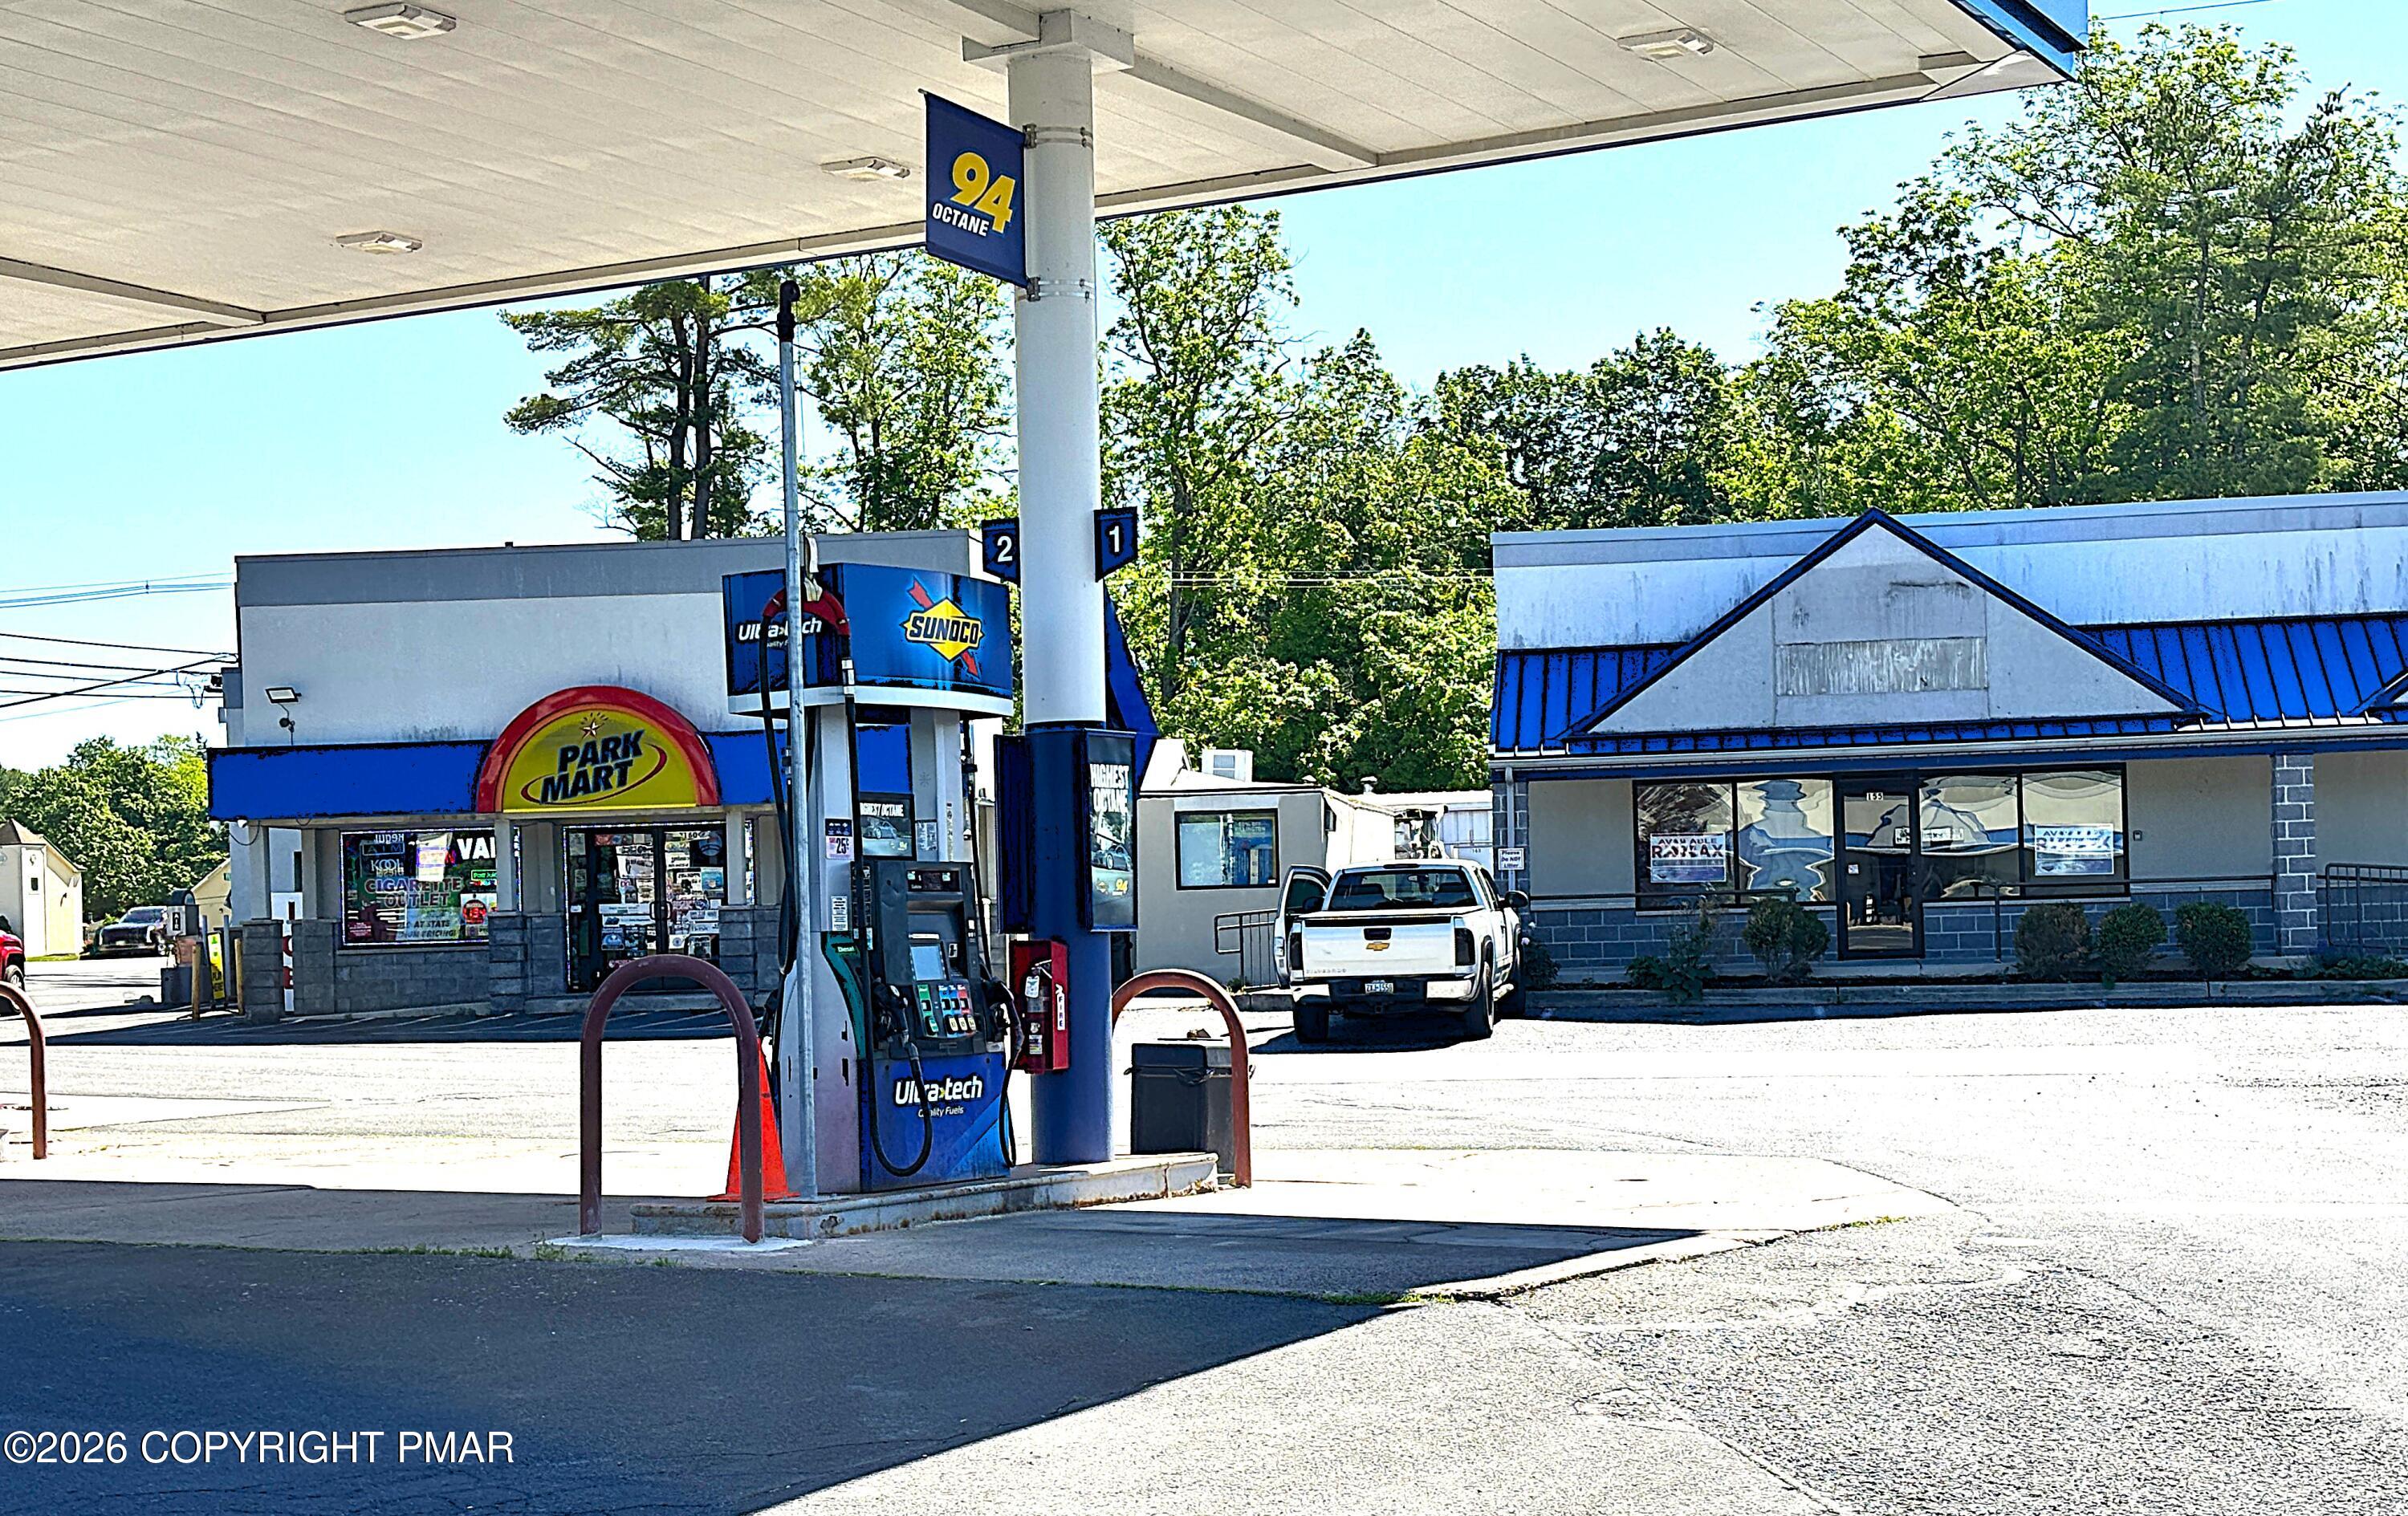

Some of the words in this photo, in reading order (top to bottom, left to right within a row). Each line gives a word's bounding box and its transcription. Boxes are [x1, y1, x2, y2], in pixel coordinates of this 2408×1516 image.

[950, 152, 1015, 234] 94
[932, 202, 990, 237] OCTANE
[997, 535, 1013, 563] 2
[1109, 525, 1120, 553] 1
[909, 616, 981, 645] SUNOCO
[558, 729, 645, 774] PARK
[539, 759, 633, 805] MART
[1090, 763, 1129, 789] HIGHEST
[860, 803, 881, 816] GHEST
[882, 804, 905, 817] OCTANE
[1093, 787, 1129, 814] OCTANE
[365, 876, 463, 893] CIGARETTE
[384, 891, 450, 908] OUTLET
[917, 1108, 945, 1118] Qality
[945, 1106, 964, 1116] Fuels
